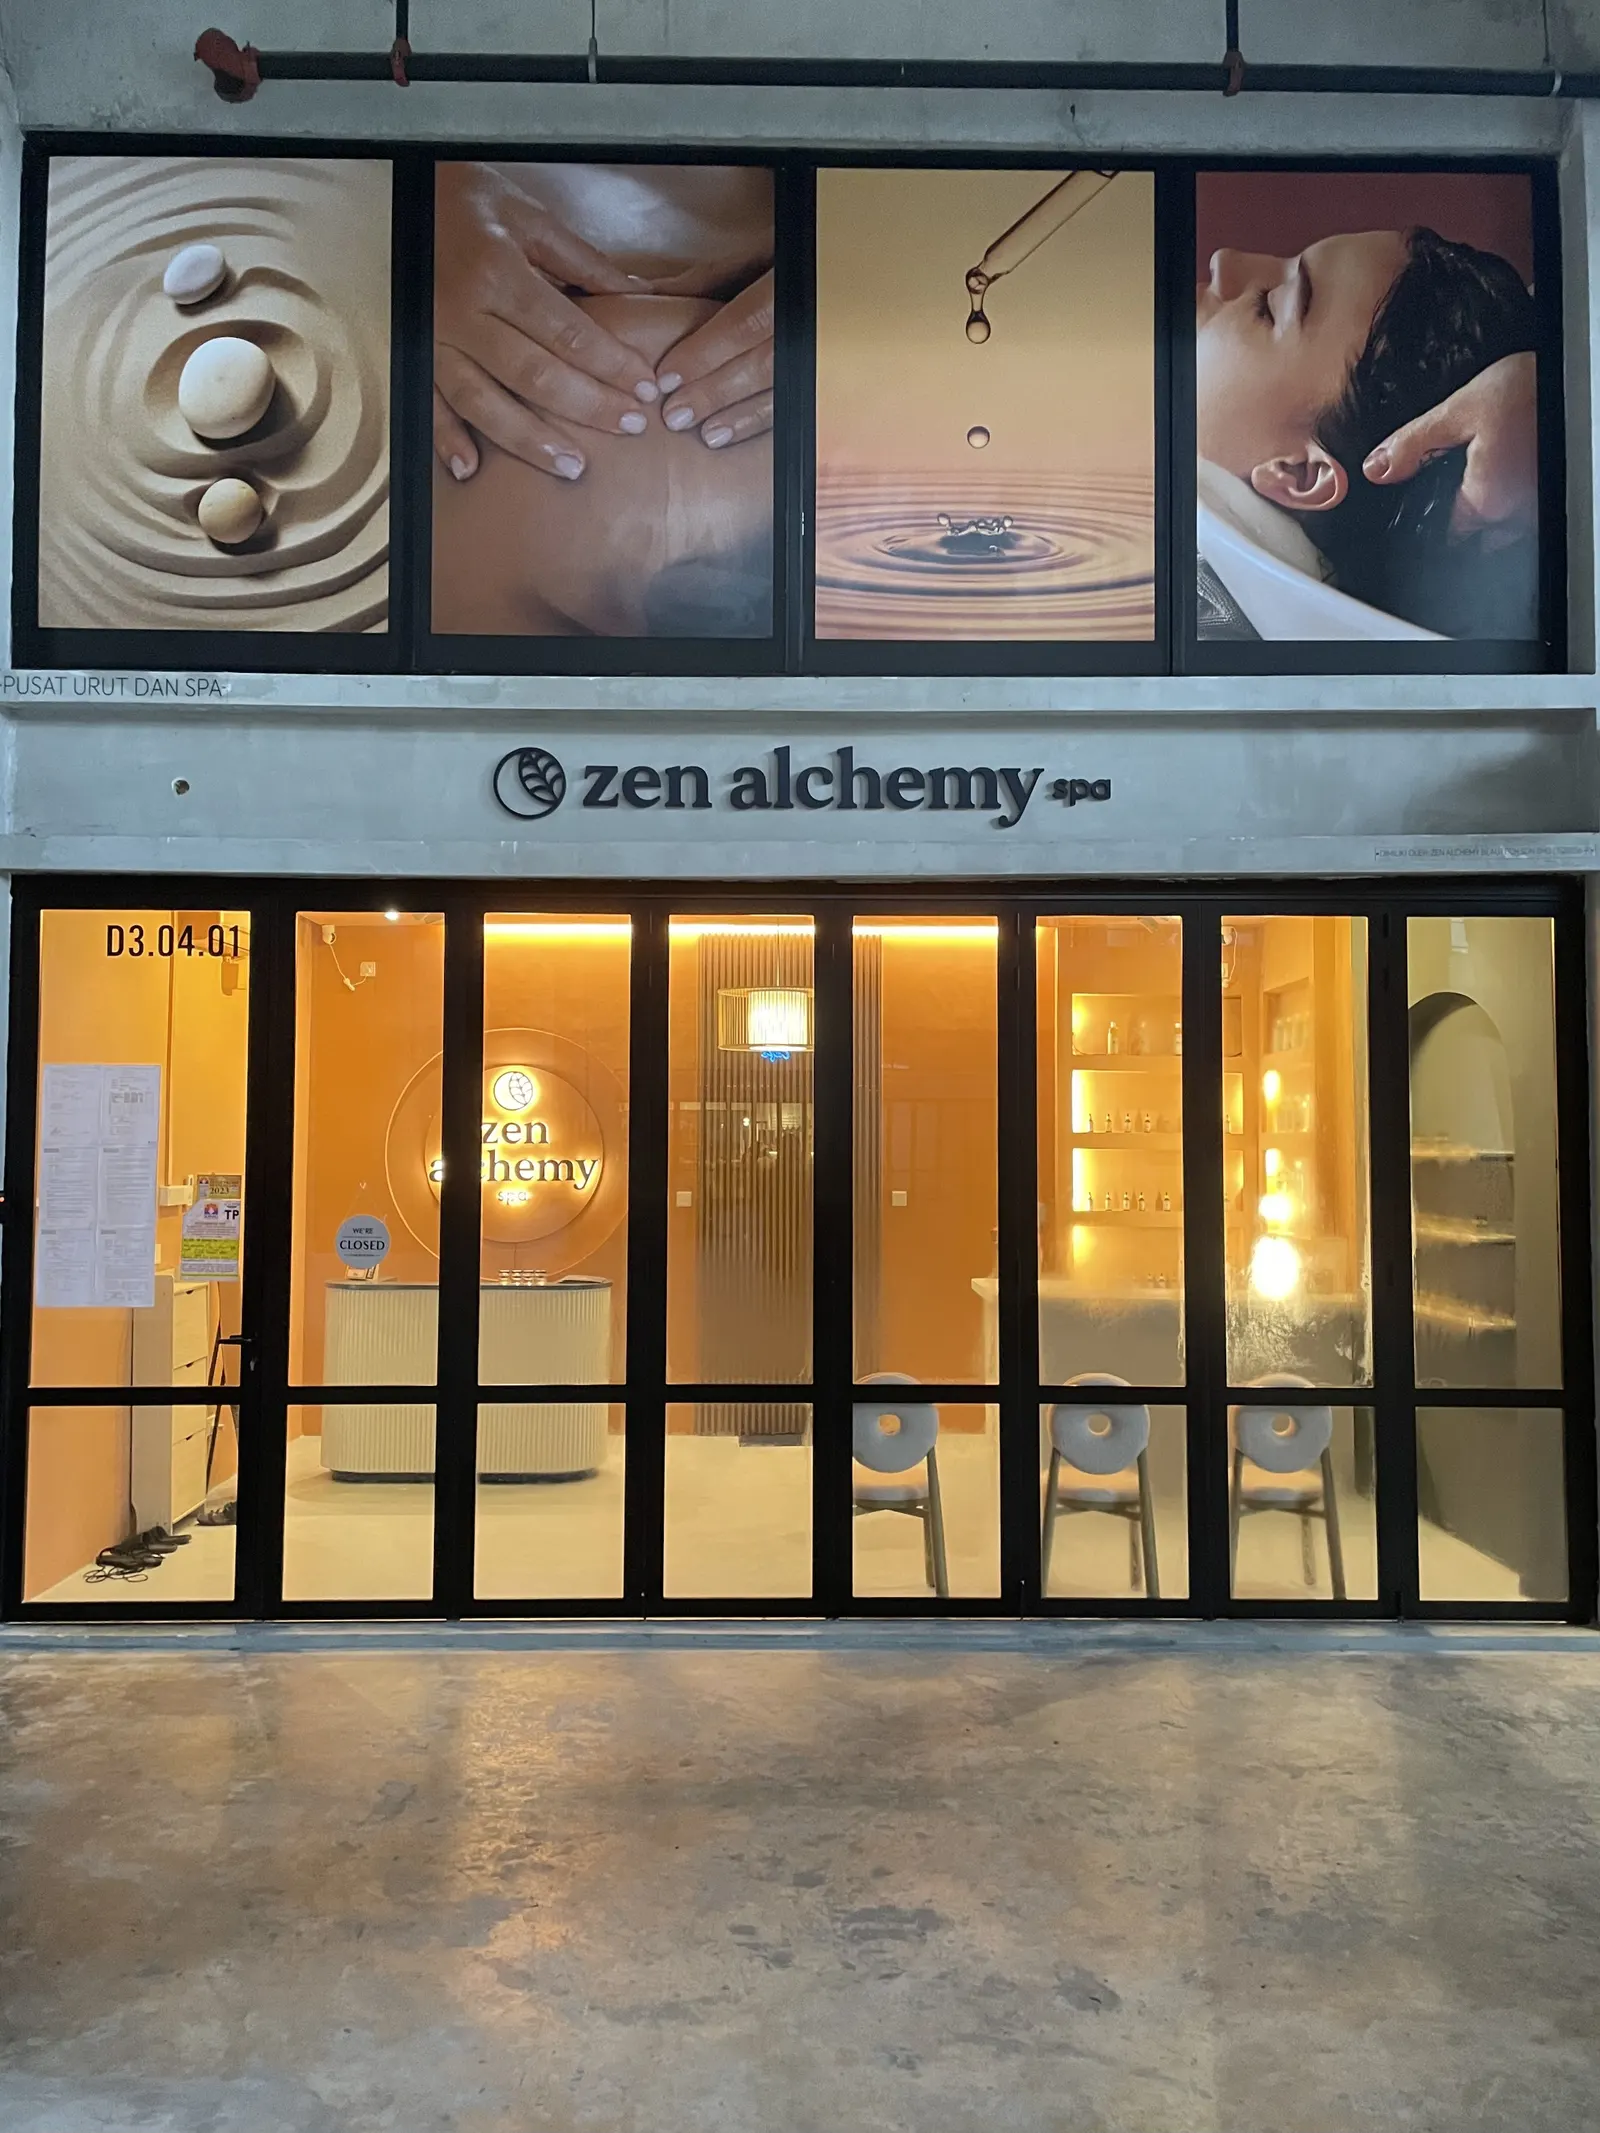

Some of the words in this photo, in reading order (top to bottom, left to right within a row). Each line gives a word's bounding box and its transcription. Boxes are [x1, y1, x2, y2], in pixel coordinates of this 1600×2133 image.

[73, 677, 128, 696] URUT
[135, 677, 178, 696] DAN
[582, 763, 712, 810] zen
[729, 745, 1045, 829] alchemy
[1052, 775, 1112, 806] spa
[106, 924, 239, 957] D3.04.01
[482, 1121, 549, 1145] zen
[429, 1149, 599, 1191] ahemy
[209, 1187, 230, 1195] 2023
[498, 1191, 527, 1206] spa
[224, 1209, 240, 1221] TP
[352, 1227, 374, 1235] WE'RE
[339, 1240, 385, 1251] CLOSED
